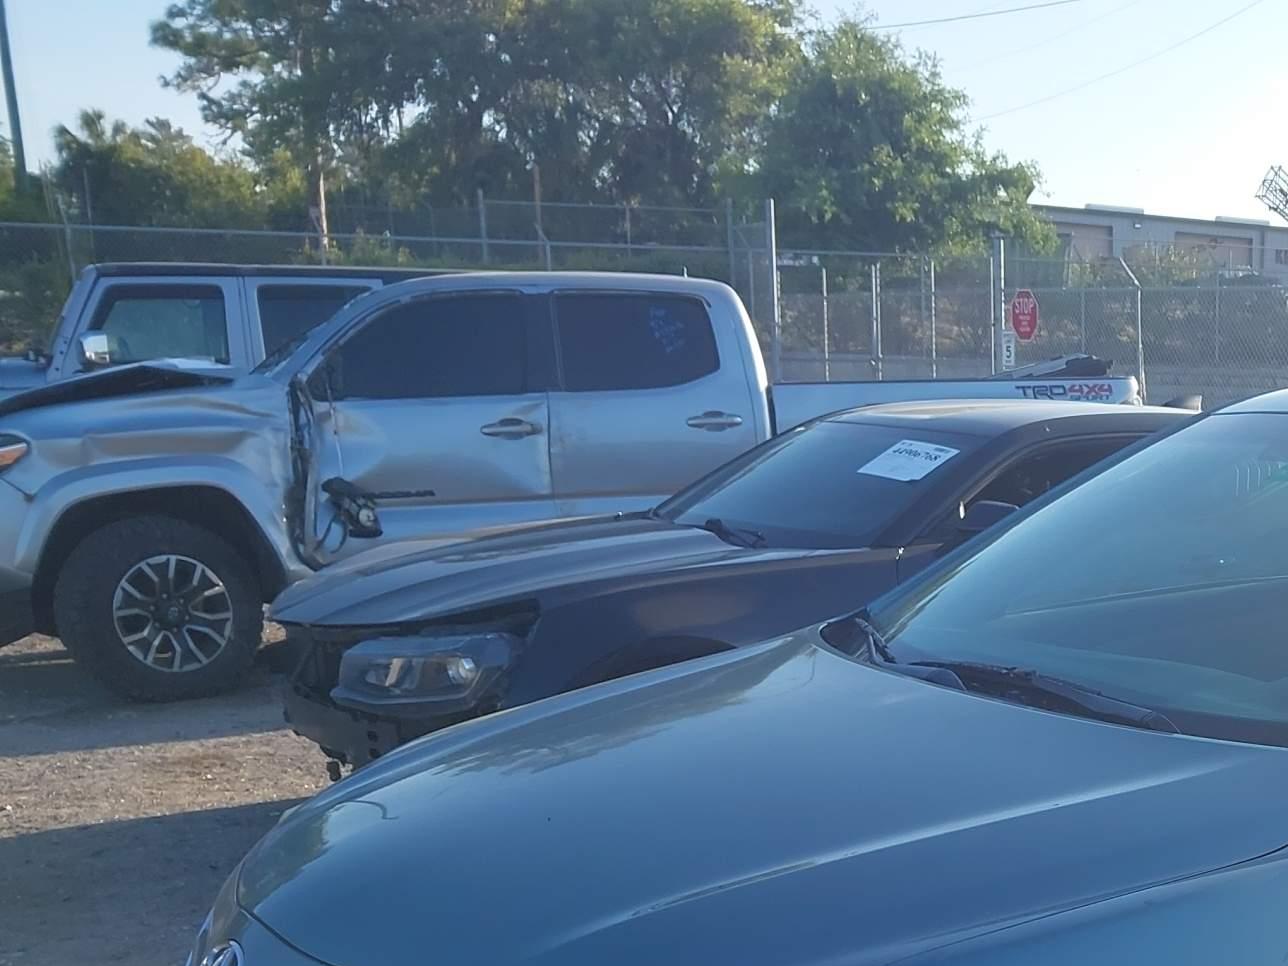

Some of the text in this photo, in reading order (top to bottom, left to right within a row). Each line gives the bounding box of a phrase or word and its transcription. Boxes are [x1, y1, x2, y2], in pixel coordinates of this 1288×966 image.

[1014, 298, 1034, 314] STOP
[1005, 345, 1012, 359] 5
[1014, 385, 1067, 400] TRD
